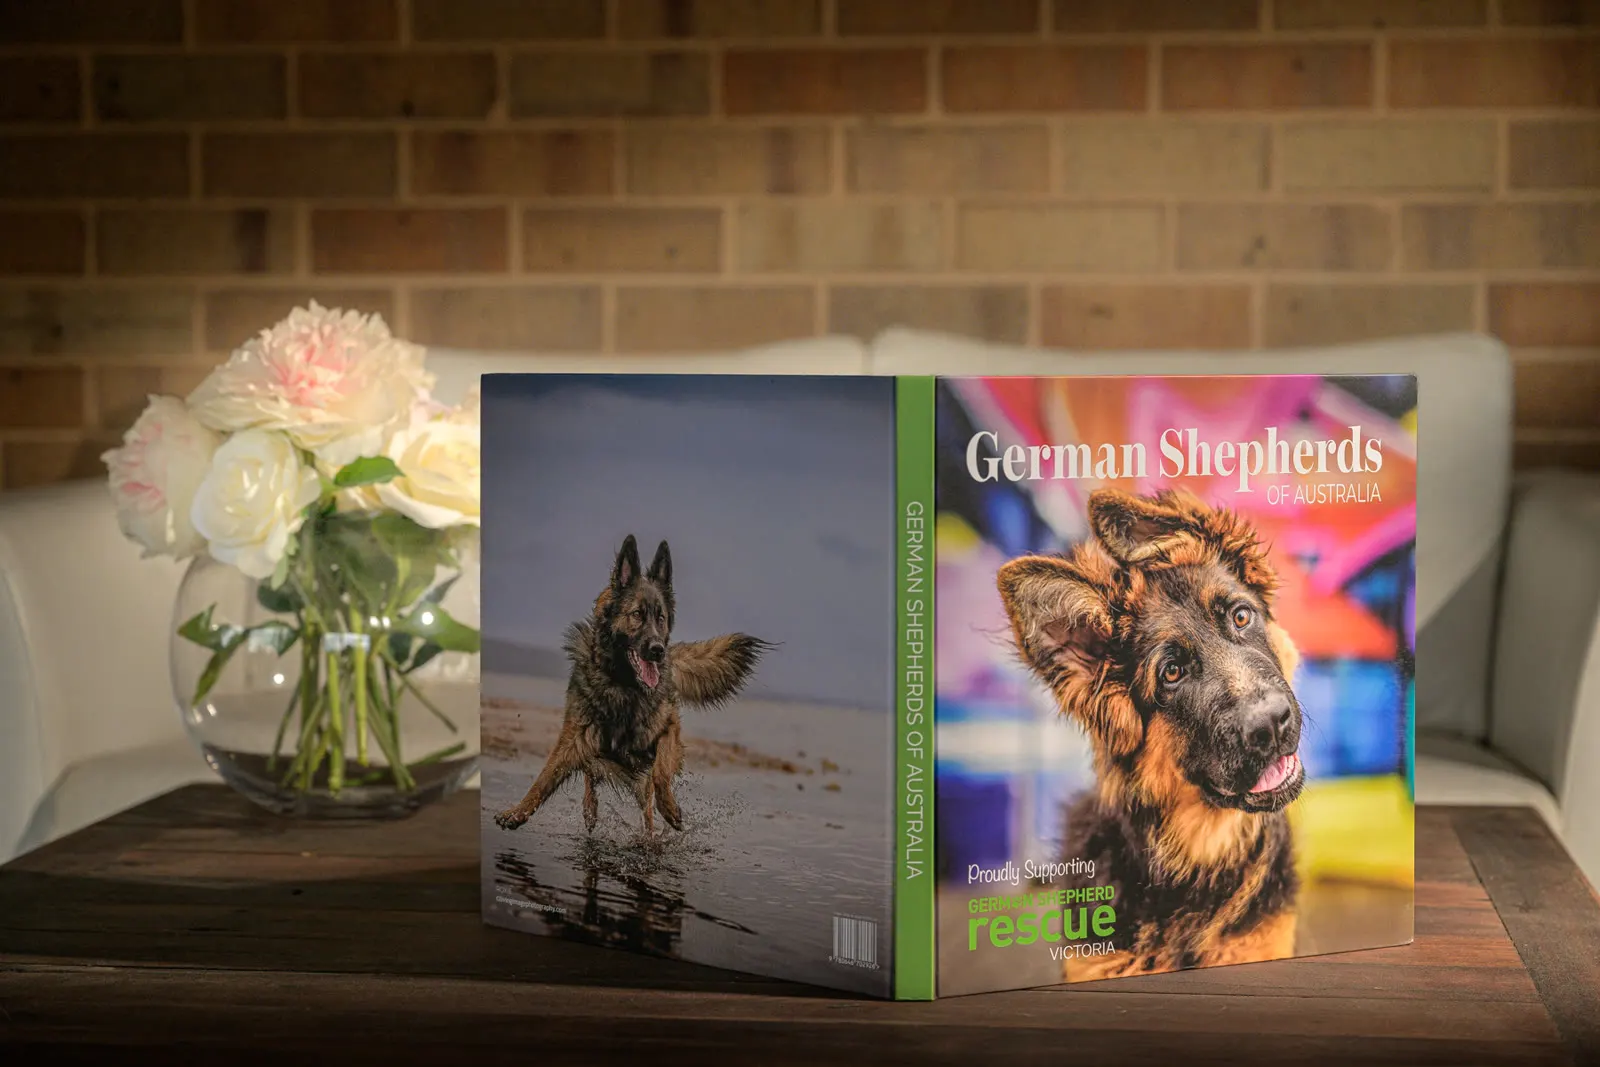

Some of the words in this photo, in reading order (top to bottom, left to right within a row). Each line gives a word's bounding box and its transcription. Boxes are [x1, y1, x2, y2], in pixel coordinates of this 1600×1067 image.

[965, 430, 1148, 483] German
[1159, 425, 1383, 492] Shepherds
[1267, 484, 1290, 505] OF
[1294, 482, 1381, 504] AUSTRALIA
[906, 501, 924, 593] GERMAN
[906, 600, 924, 726] SHEPHERDS
[906, 731, 924, 760] OF
[906, 764, 924, 880] AUSTRALIA
[968, 860, 1020, 886] Proudly
[1024, 857, 1095, 884] Supporting
[1037, 885, 1115, 907] SHEPHERD
[968, 904, 1116, 951] rescue
[1050, 941, 1116, 961] VICTORIA
